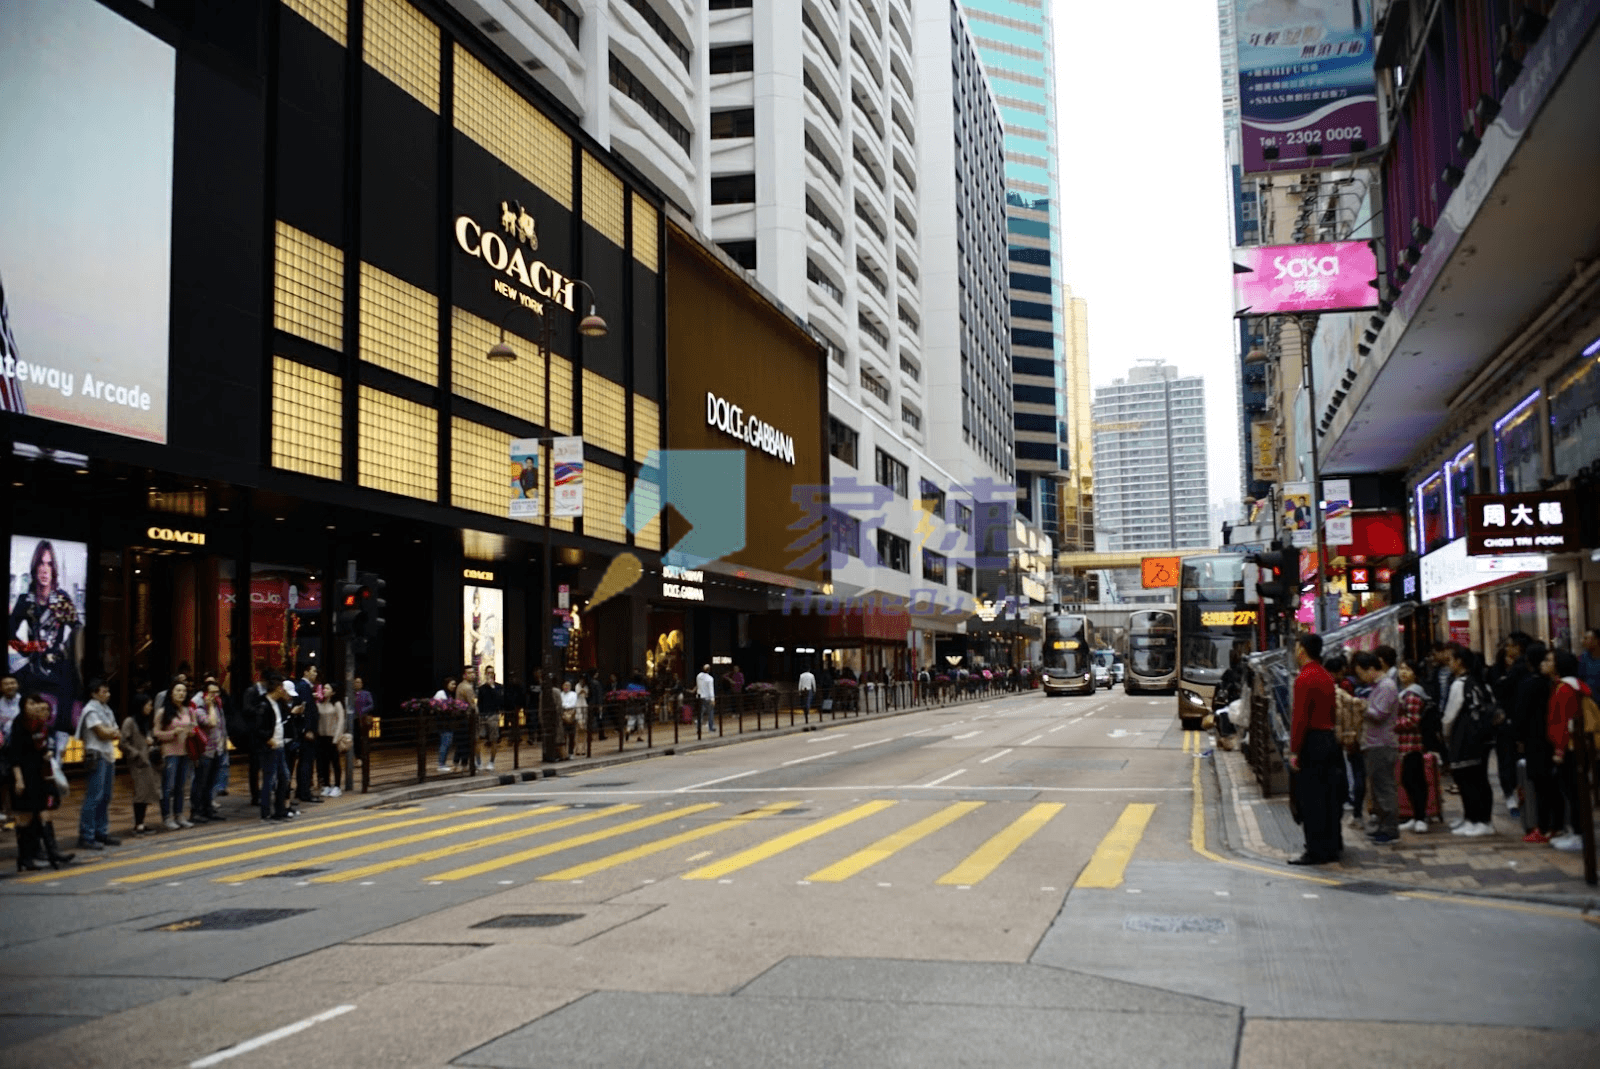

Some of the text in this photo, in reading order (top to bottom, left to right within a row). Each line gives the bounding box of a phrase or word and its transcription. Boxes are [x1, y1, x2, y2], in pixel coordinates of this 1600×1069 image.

[1286, 130, 1322, 145] 2302
[1325, 126, 1362, 141] 0002
[455, 216, 575, 312] COACH
[494, 279, 544, 316] NEW YORK
[0, 352, 152, 411] teway Arcade
[1482, 502, 1564, 527] 周大福
[147, 526, 206, 546] COACH
